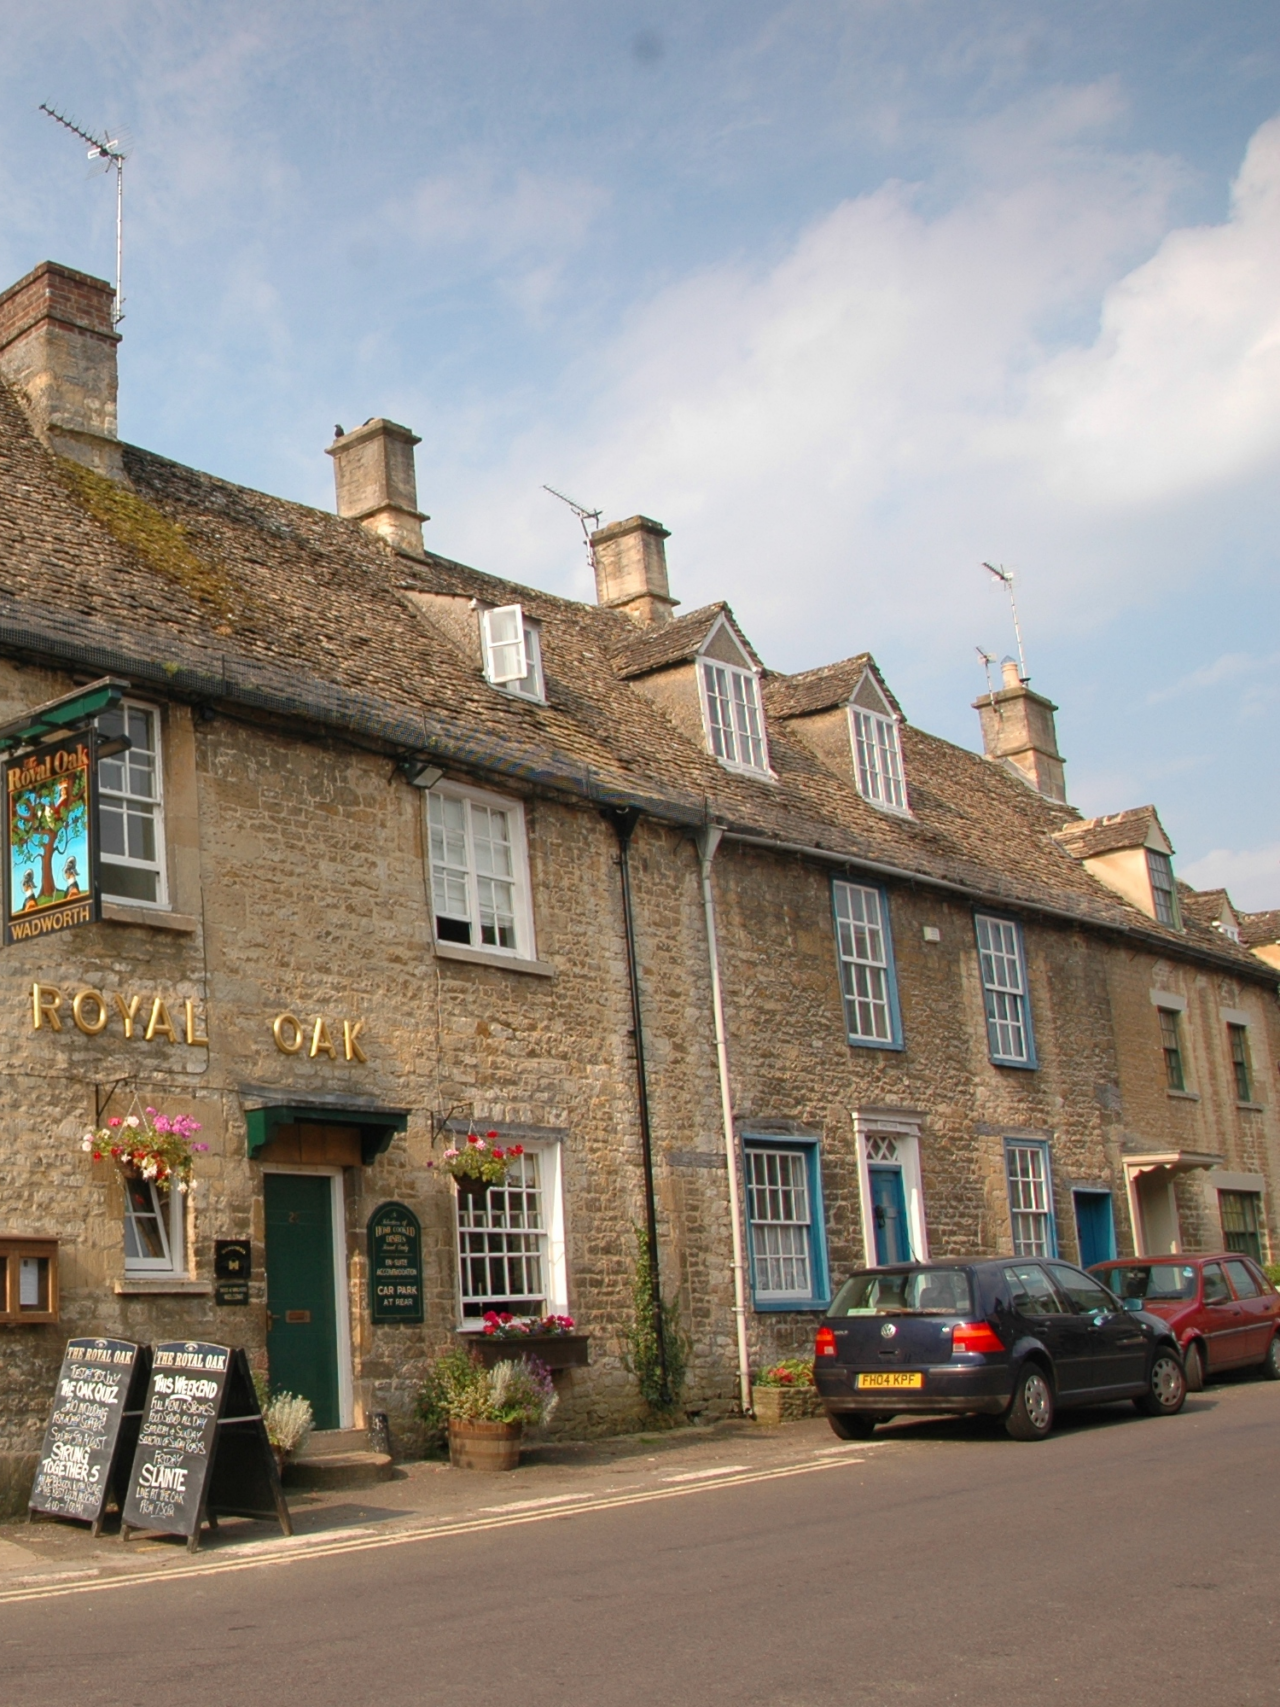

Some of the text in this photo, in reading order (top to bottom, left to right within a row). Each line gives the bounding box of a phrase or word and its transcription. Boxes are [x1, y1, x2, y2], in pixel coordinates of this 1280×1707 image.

[8, 744, 89, 792] Royal Oak
[12, 906, 90, 940] WADWORTH
[29, 982, 209, 1046] ROYAL
[272, 1014, 368, 1063] OAK
[378, 1286, 418, 1295] CAR PARK
[68, 1347, 132, 1364] THE ROYAL OAK
[156, 1352, 226, 1369] THE ROYAL OAK
[60, 1379, 118, 1404] THE OAK QUIZ
[154, 1374, 218, 1399] THIS WEEKEND
[862, 1374, 915, 1386] FH04 KPF
[51, 1442, 90, 1464] STRUNG
[154, 1450, 184, 1466] FRIDAY
[42, 1458, 90, 1482] TOGETHER
